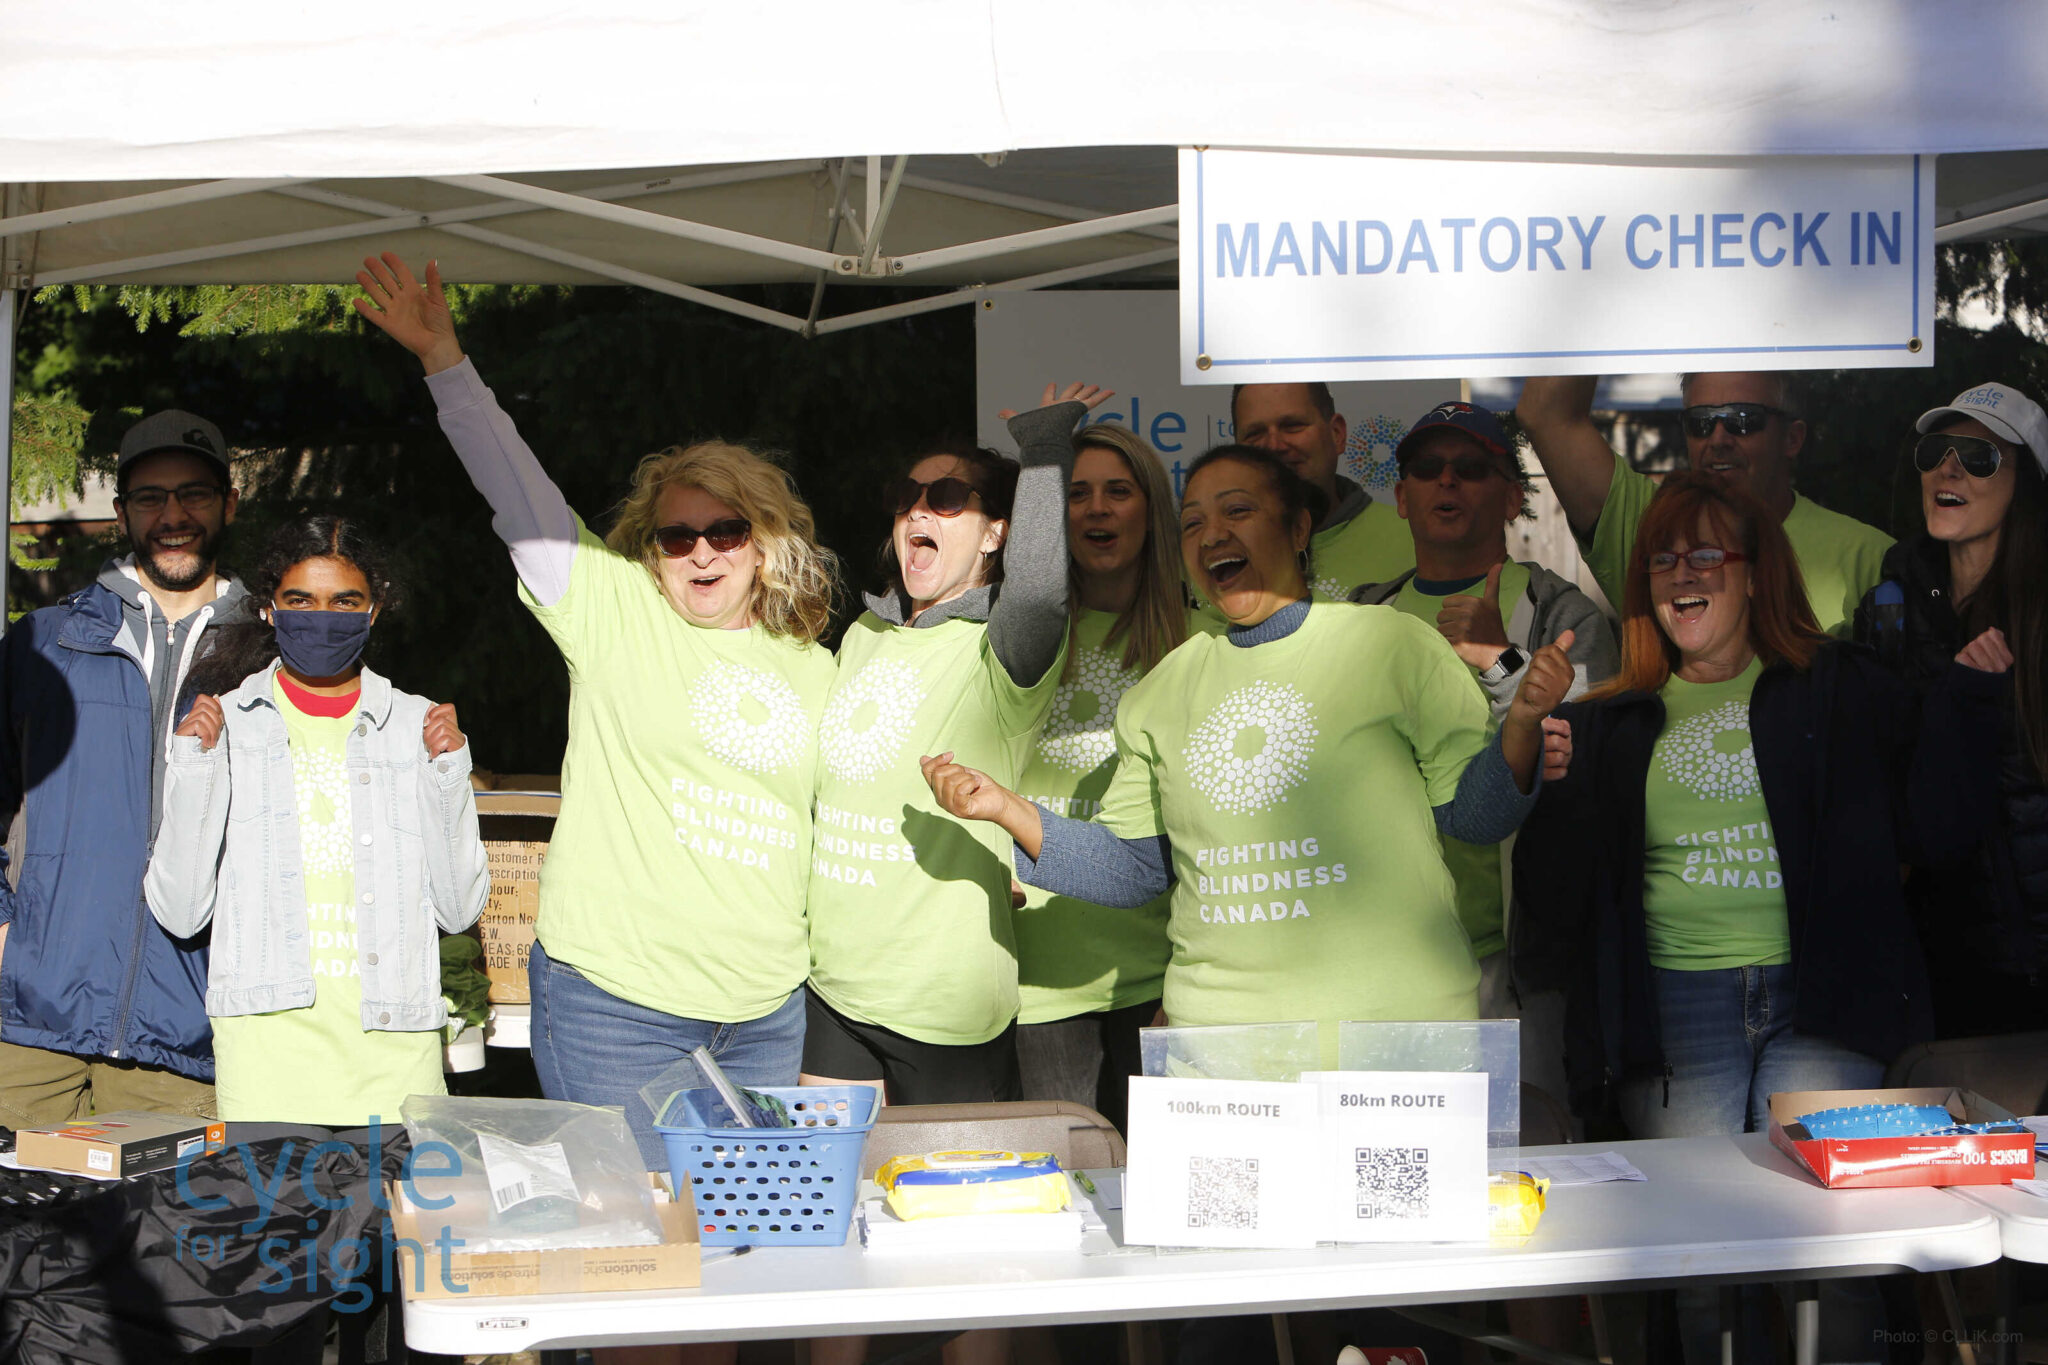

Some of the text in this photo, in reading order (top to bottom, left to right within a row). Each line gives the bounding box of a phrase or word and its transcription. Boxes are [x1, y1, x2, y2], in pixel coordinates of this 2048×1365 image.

[1215, 210, 1902, 279] MANDATORY CHECK IN
[671, 777, 787, 820] FIGHTING
[672, 802, 796, 850] BLINDNESS
[487, 852, 533, 865] ustomer
[674, 827, 770, 871] CANADA
[1196, 837, 1319, 868] FIGHTING
[1198, 863, 1347, 895] BLINDNESS
[485, 898, 502, 911] ty:
[1199, 899, 1310, 925] CANADA
[480, 912, 515, 924] Carton
[483, 956, 510, 969] ADE
[1168, 1100, 1281, 1118] 100km ROUTE
[1340, 1093, 1445, 1108] 80km ROUTE
[1962, 1151, 1987, 1165] 100
